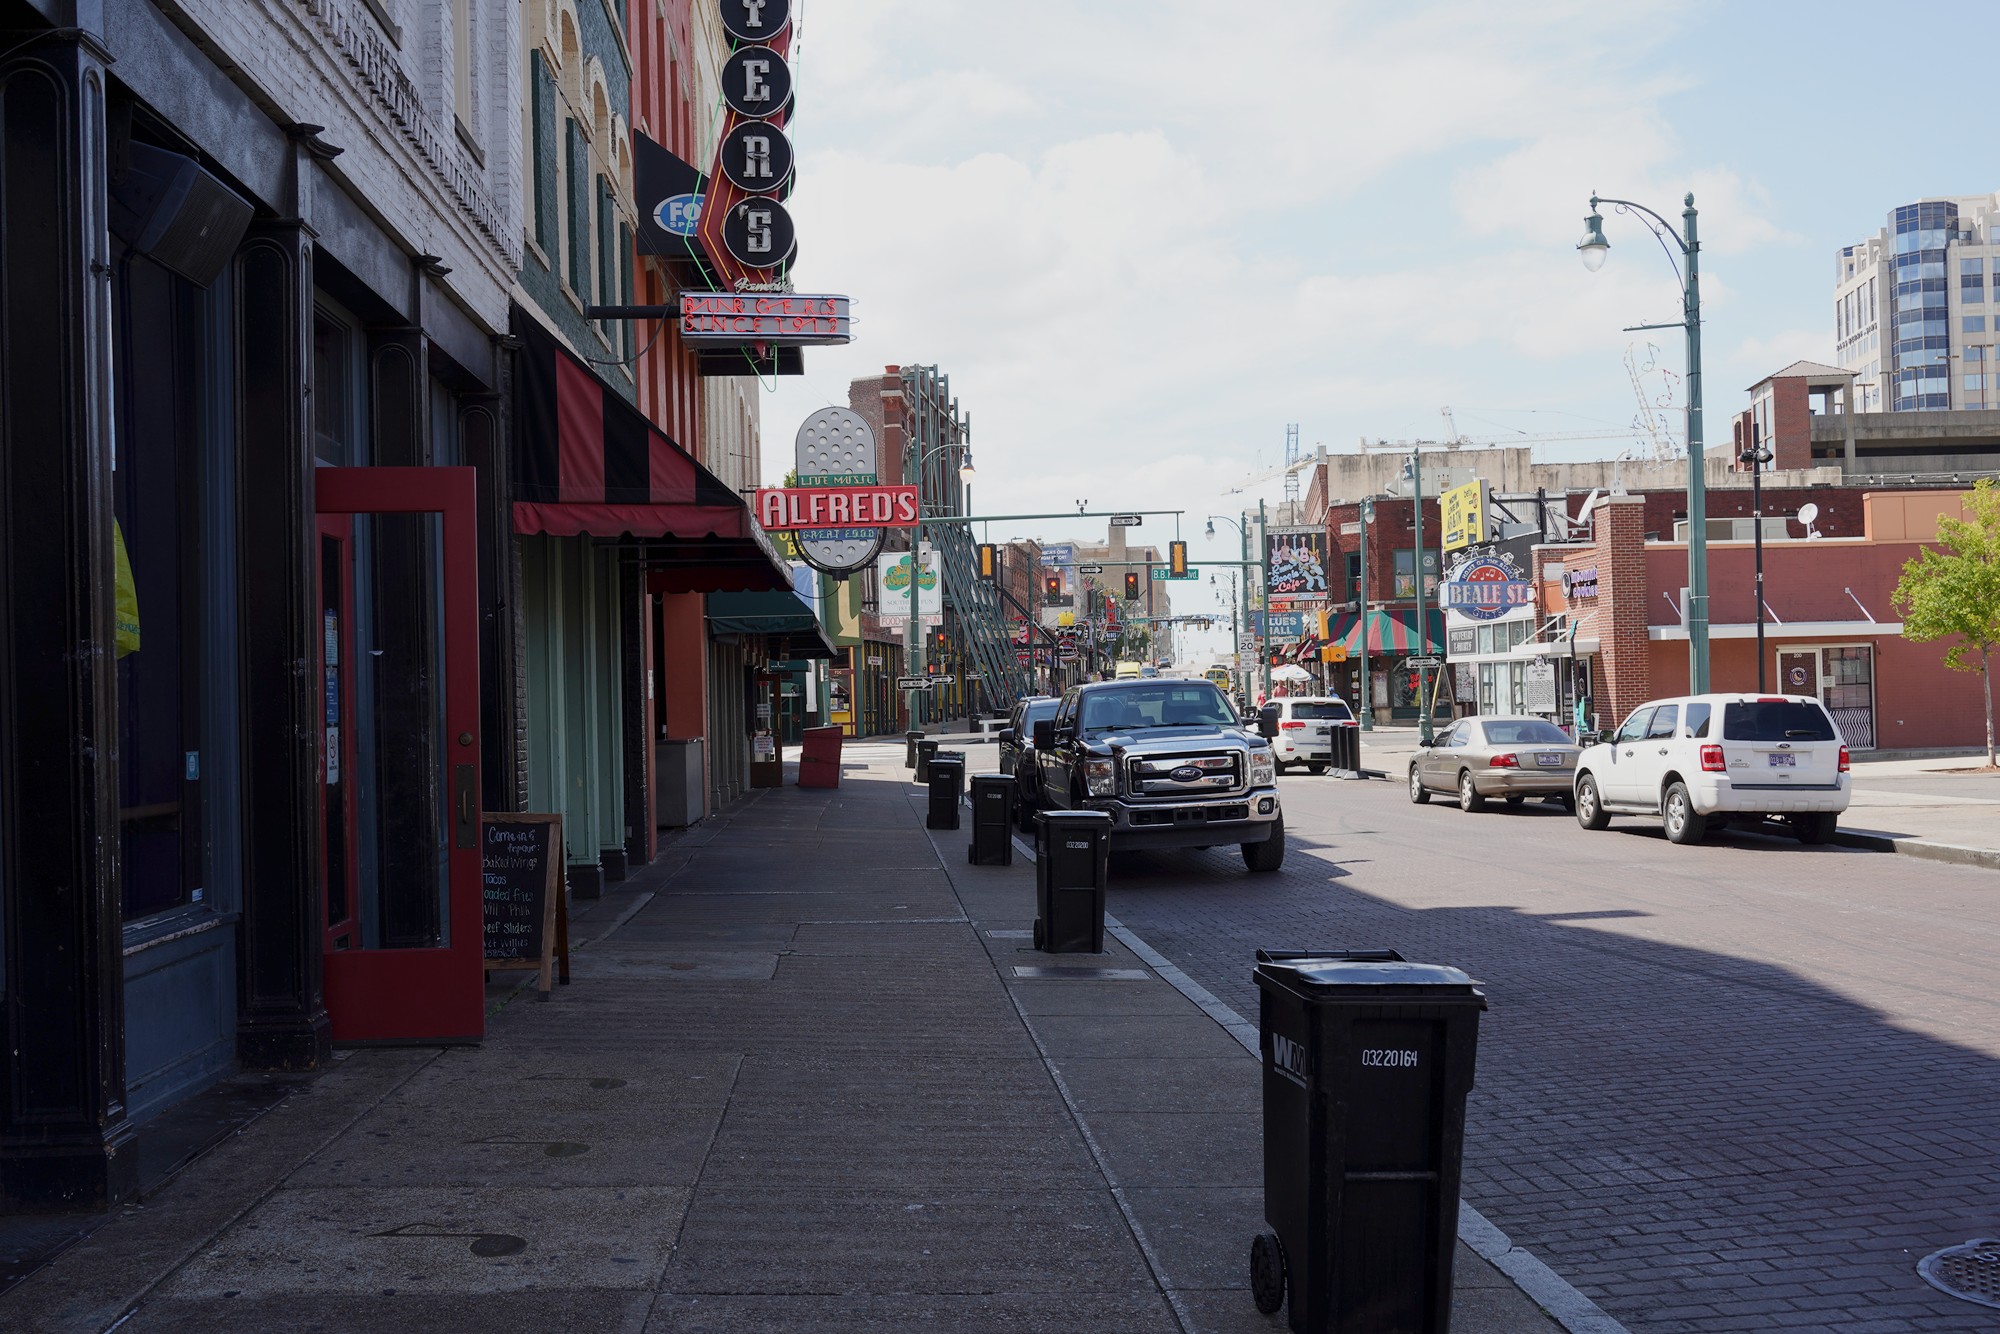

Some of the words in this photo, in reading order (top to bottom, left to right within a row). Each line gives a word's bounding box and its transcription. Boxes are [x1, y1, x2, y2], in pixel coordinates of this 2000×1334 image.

[669, 202, 704, 221] FO
[684, 297, 837, 315] BURGERS
[684, 315, 763, 333] SINCE
[774, 316, 838, 333] 1912
[800, 476, 828, 486] LIVE
[833, 475, 873, 485] MUSIC
[762, 491, 916, 527] ALFRED'S
[802, 529, 840, 540] GREAT
[845, 529, 875, 539] FOOD
[1153, 570, 1167, 579] B.B.
[1449, 584, 1502, 604] BEALE
[1506, 583, 1527, 605] ST.
[1472, 608, 1504, 619] GIFTS
[1261, 616, 1297, 626] LUES
[1241, 642, 1254, 650] 20
[1177, 769, 1196, 778] Ford
[488, 826, 516, 844] Come
[483, 872, 507, 885] Tacos
[483, 887, 510, 901] oaded
[502, 922, 533, 935] Sliders
[1272, 1031, 1308, 1081] WM
[1362, 1049, 1418, 1067] 03220164
